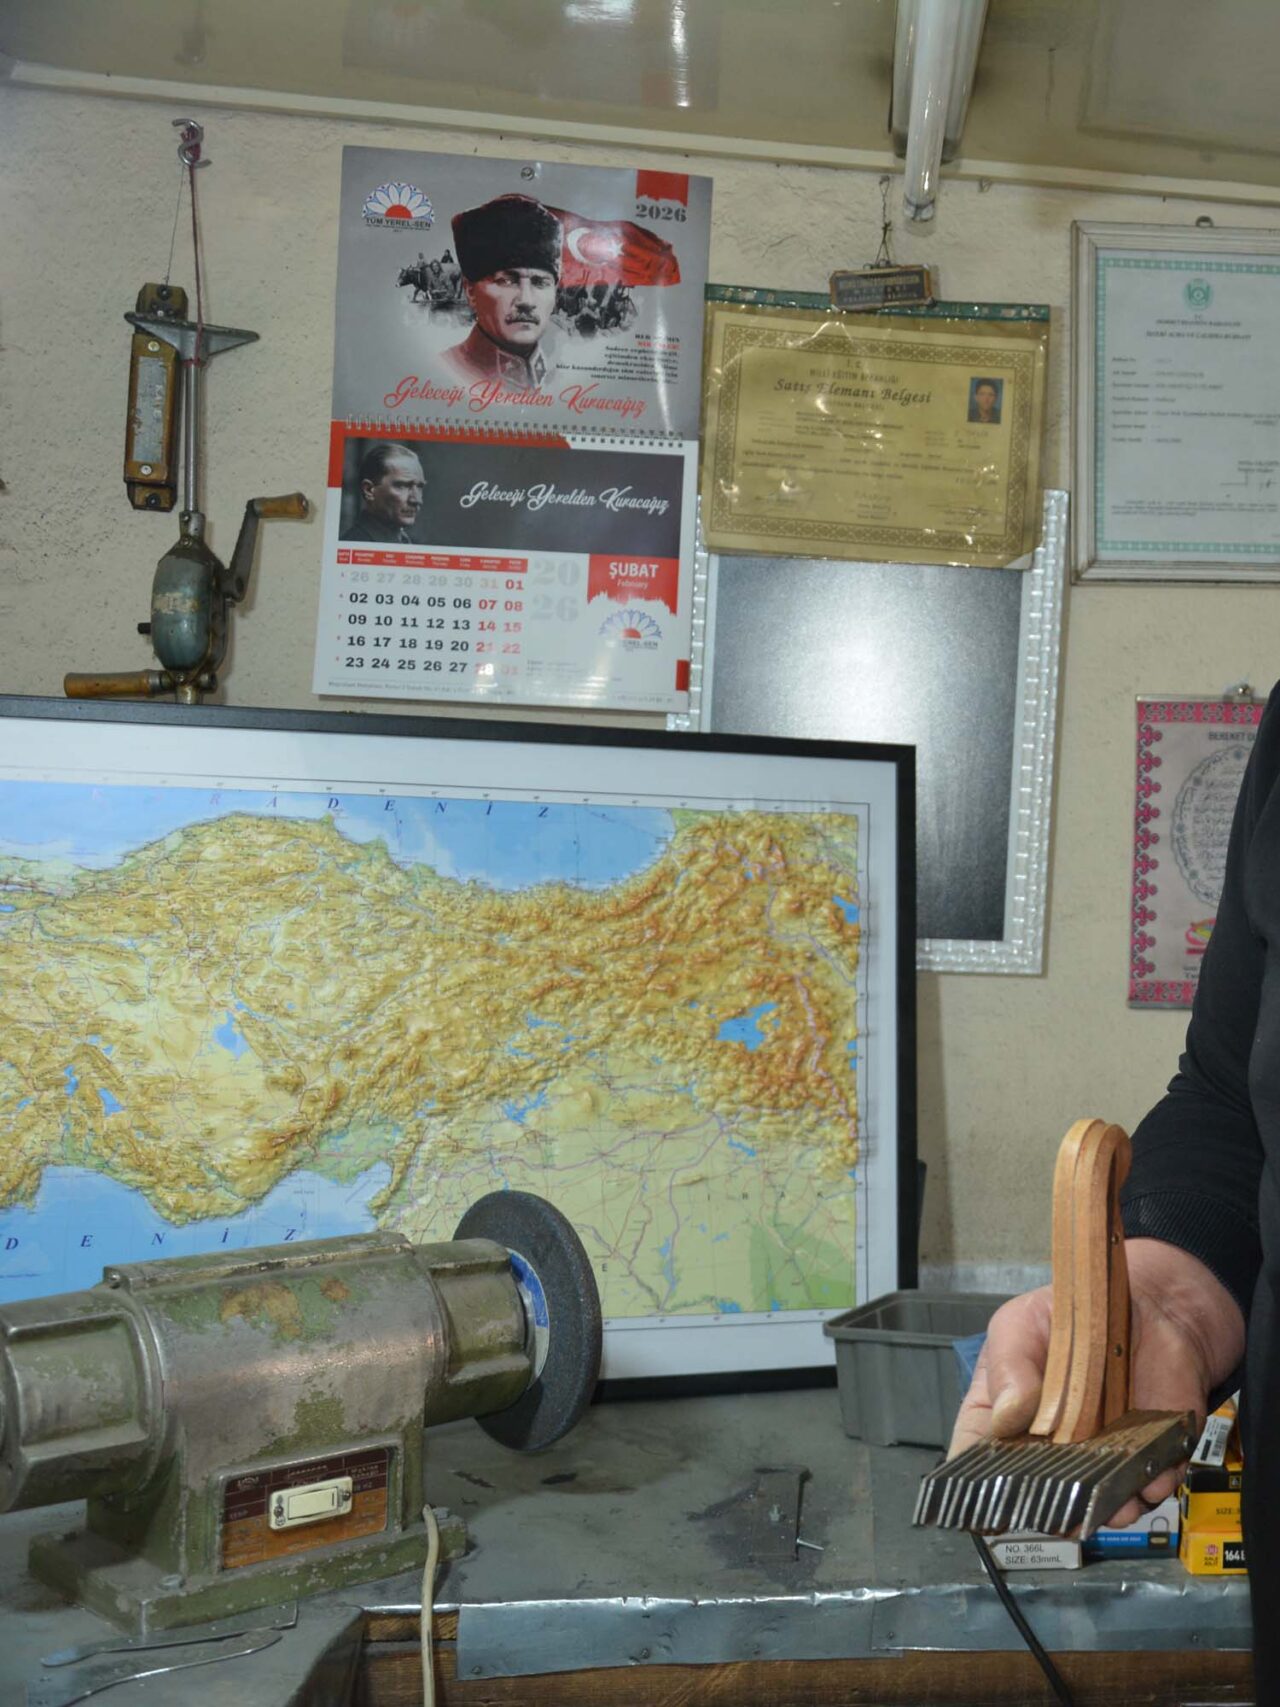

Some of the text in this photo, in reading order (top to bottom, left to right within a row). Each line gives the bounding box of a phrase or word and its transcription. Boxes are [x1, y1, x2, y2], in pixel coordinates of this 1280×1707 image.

[636, 203, 688, 223] 2026
[384, 376, 646, 417] Geleceği Yerelden Kuracağız
[774, 378, 811, 393] Satış
[816, 382, 875, 399] Elemanı
[881, 388, 932, 406] Belgesi
[460, 481, 670, 516] Geleceği Yerelden Kuracağız
[609, 562, 659, 579] ŞUBAT
[505, 579, 524, 590] 01
[617, 579, 649, 590] February
[350, 593, 368, 604] 02
[375, 594, 394, 605] 03
[401, 595, 420, 606] 04
[427, 597, 446, 607] 05
[453, 598, 471, 609] 06
[478, 599, 497, 610] 07
[504, 600, 523, 611] 08
[348, 614, 367, 625] 09
[374, 616, 392, 626] 10
[401, 617, 418, 628] 11
[426, 618, 444, 629] 12
[452, 619, 470, 630] 13
[478, 621, 496, 632] 14
[504, 622, 522, 633] 15
[347, 636, 365, 647] 16
[373, 637, 391, 648] 17
[399, 638, 417, 649] 18
[425, 640, 443, 651] 19
[451, 641, 469, 652] 20
[502, 643, 520, 654] 22
[345, 657, 364, 668] 23
[371, 658, 390, 669] 24
[397, 660, 416, 671] 25
[423, 661, 442, 672] 26
[449, 662, 468, 673] 27
